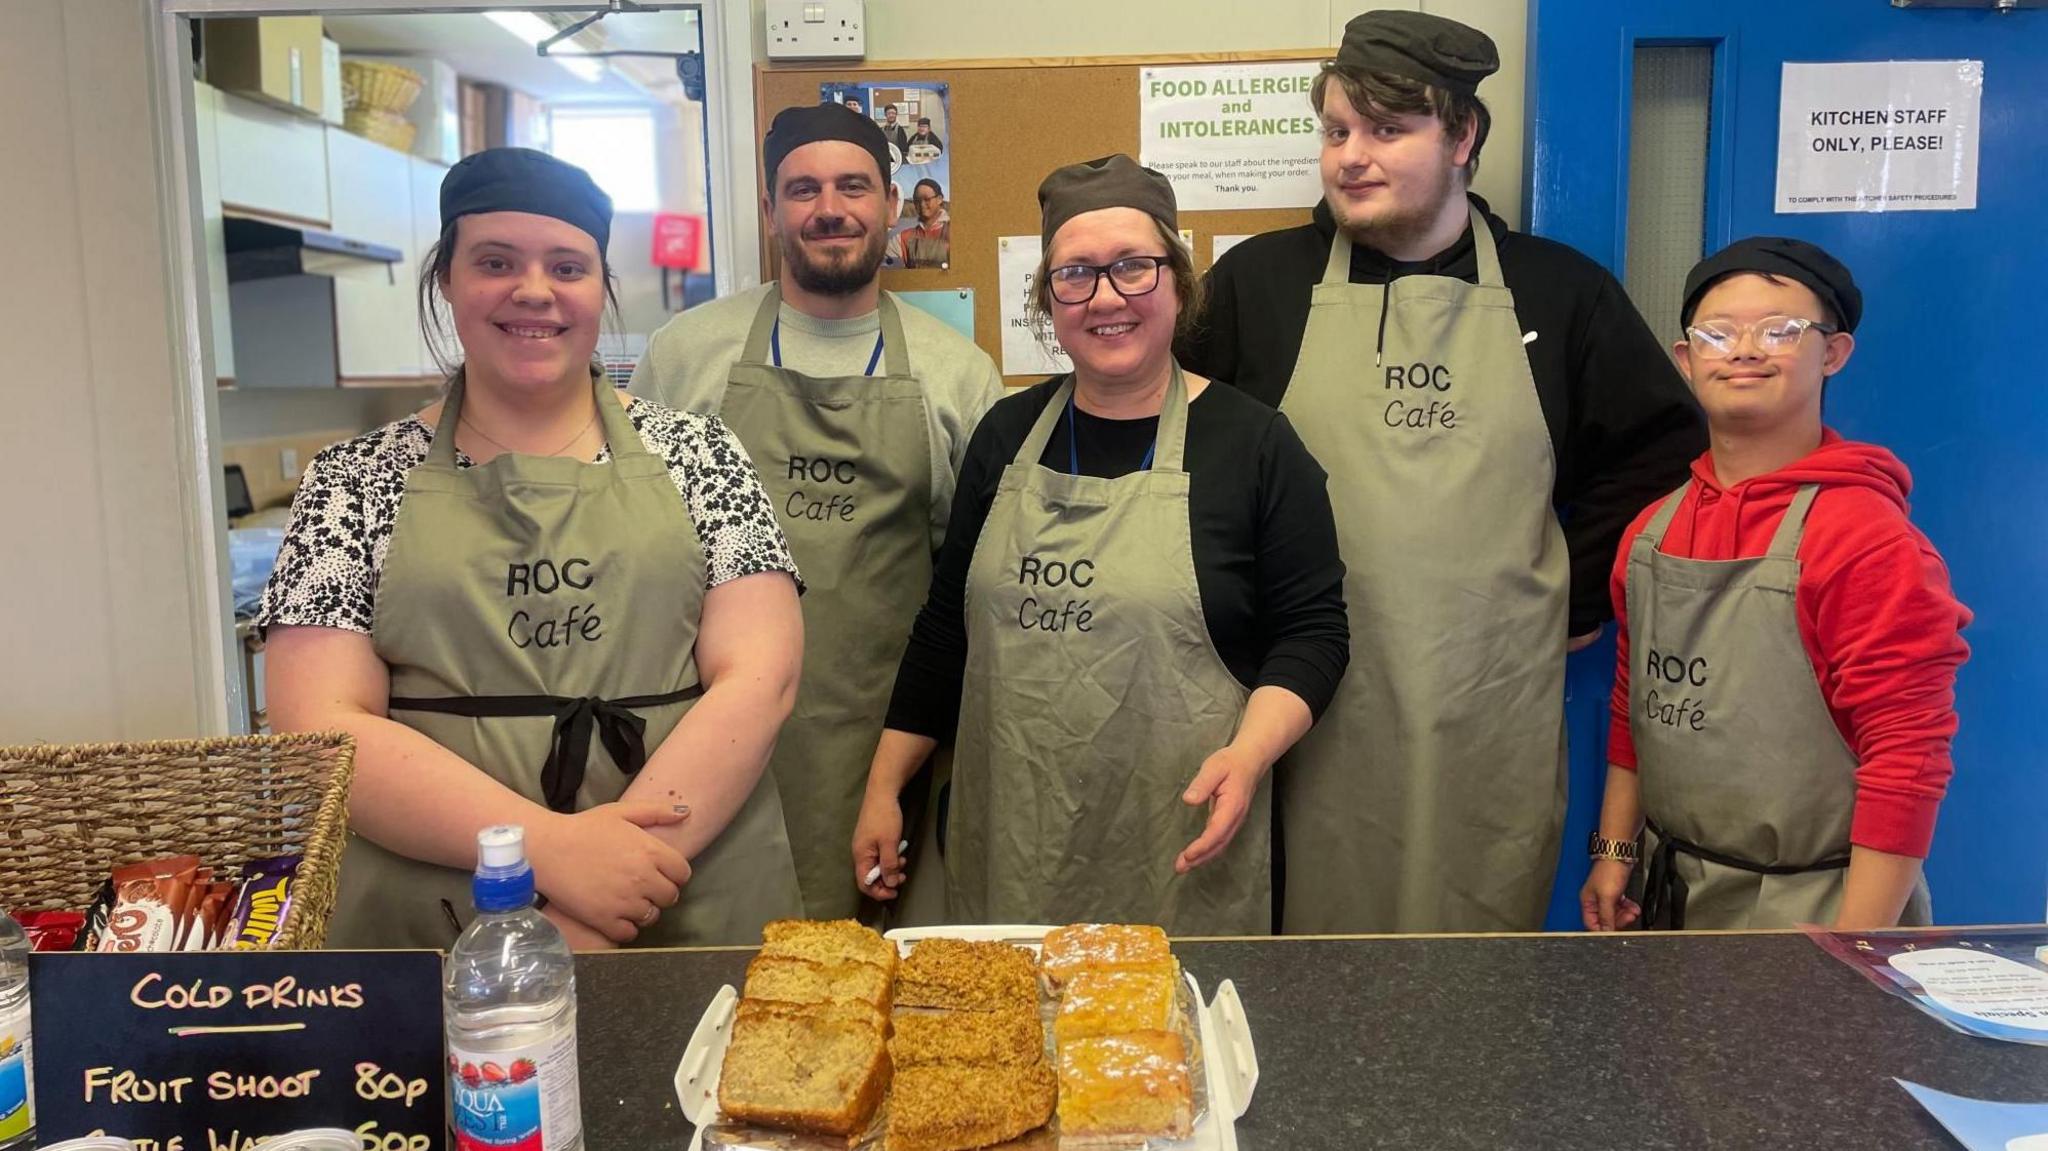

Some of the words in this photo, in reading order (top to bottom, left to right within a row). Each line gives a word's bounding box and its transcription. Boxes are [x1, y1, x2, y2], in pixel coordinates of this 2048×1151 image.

[1150, 80, 1207, 98] FOOD
[1212, 76, 1311, 96] ALLERGIE
[1221, 99, 1252, 114] and
[1811, 111, 1888, 126] KITCHEN
[1894, 109, 1947, 124] STAFF
[1160, 117, 1314, 138] INTOLERANCES
[1812, 136, 1864, 153] ONLY,
[1871, 135, 1943, 151] PLEASE!
[1149, 161, 1173, 170] Please
[1175, 161, 1198, 171] speak
[1200, 161, 1208, 169] to
[1224, 159, 1241, 168] staff
[1243, 159, 1265, 168] about
[1267, 158, 1280, 167] the
[1281, 157, 1321, 169] ingredient
[1172, 173, 1190, 183] your
[1192, 171, 1213, 182] meal,
[1215, 170, 1236, 180] when
[1238, 169, 1267, 181] making
[1268, 170, 1286, 180] your
[1215, 184, 1240, 193] Thank
[1385, 362, 1451, 392] ROC
[1384, 399, 1456, 430] Café
[788, 456, 856, 485] ROC
[785, 491, 855, 522] Café
[507, 558, 593, 597] ROC
[1019, 556, 1094, 588] ROC
[508, 603, 602, 649] Café
[1019, 597, 1093, 632] Café
[1647, 649, 1707, 687] ROC
[1646, 689, 1705, 731] Café
[236, 876, 289, 950] Twir
[131, 973, 233, 1010] COLD
[242, 975, 365, 1009] DRINKS
[84, 1066, 193, 1103] FRUIT
[208, 1069, 320, 1100] SHOOT
[355, 1061, 428, 1108] 80p
